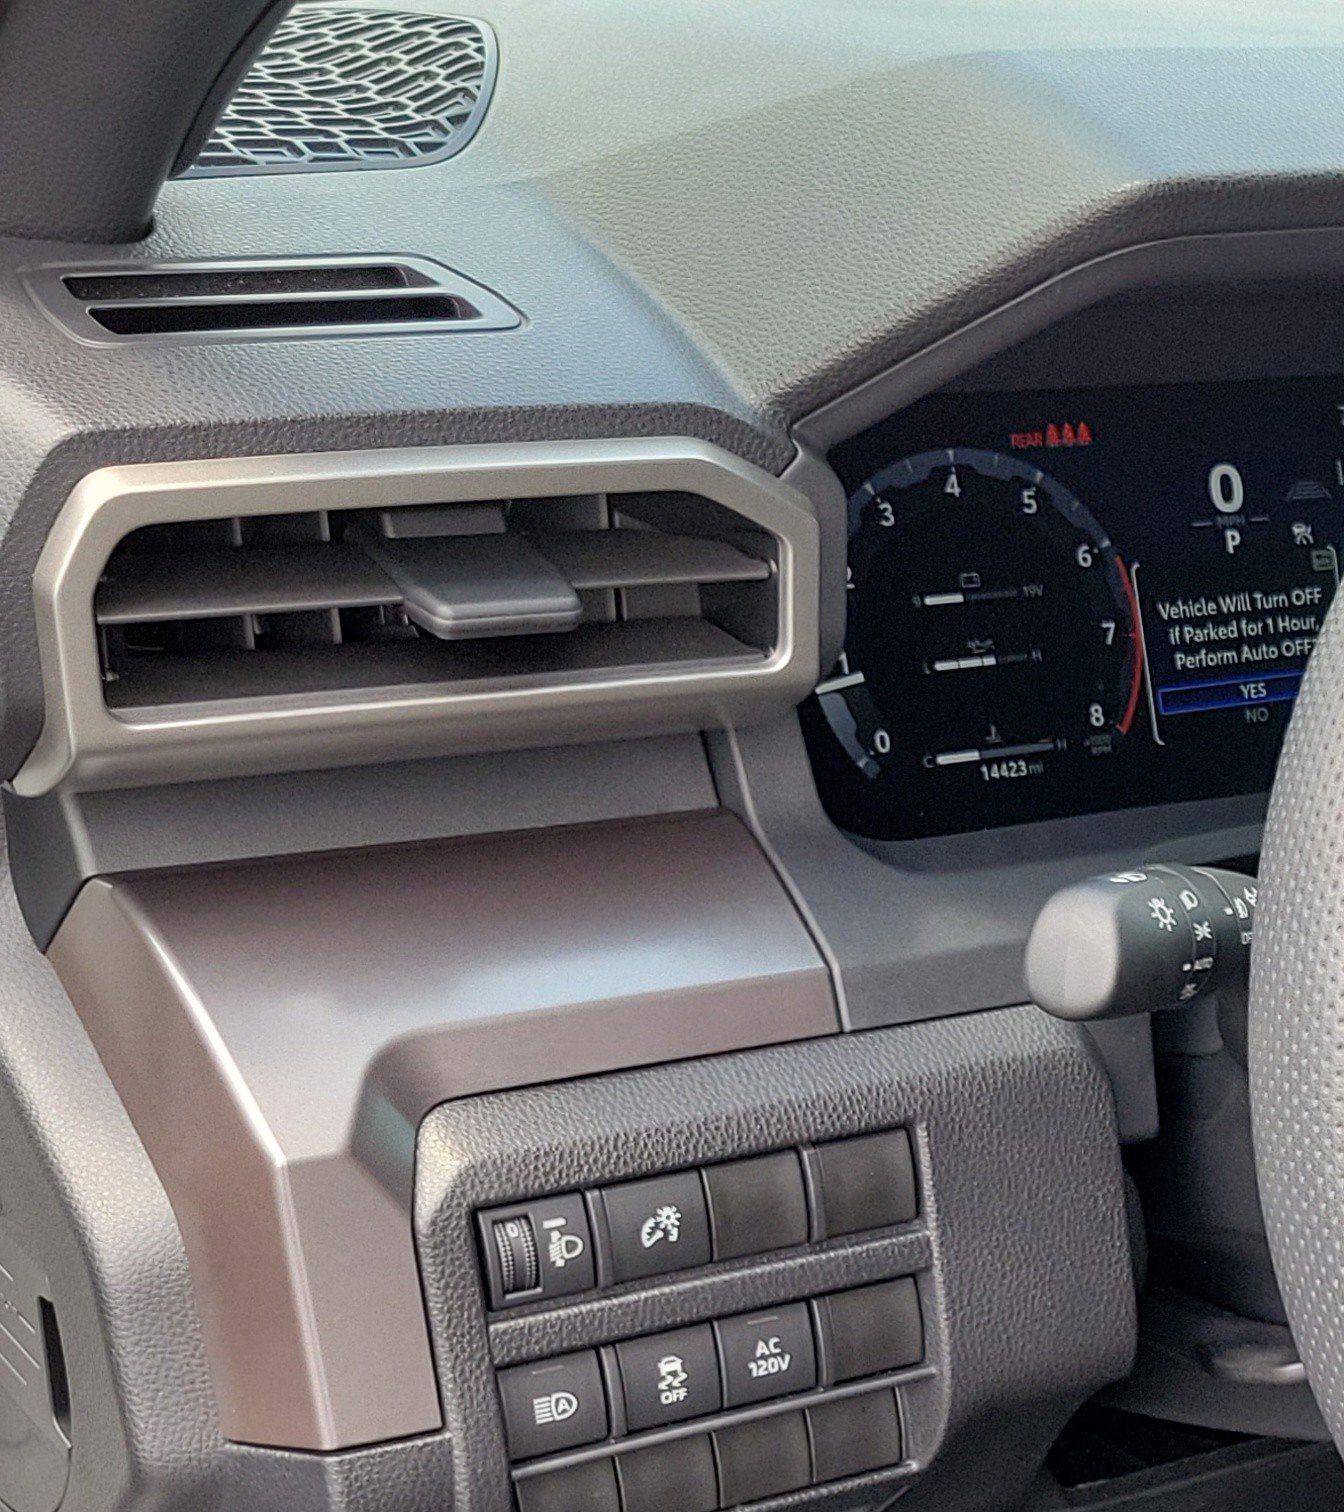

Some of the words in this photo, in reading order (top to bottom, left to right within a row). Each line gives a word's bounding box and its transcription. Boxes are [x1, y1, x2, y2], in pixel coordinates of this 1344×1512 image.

[1011, 433, 1043, 449] REAR
[944, 473, 962, 498] 4
[1208, 463, 1244, 513] 0
[878, 502, 896, 527] 3
[1022, 489, 1038, 515] 5
[1225, 528, 1242, 554] P
[1077, 544, 1093, 568] 6
[1157, 598, 1217, 620] Vehicle
[1218, 591, 1252, 614] Will
[1253, 591, 1289, 610] Turn
[1292, 587, 1322, 606] OFF
[1101, 620, 1116, 646] 7
[1184, 621, 1239, 644] Parked
[1242, 620, 1263, 638] for
[1266, 618, 1274, 634] 1
[1278, 615, 1320, 633] Hour,
[1175, 648, 1239, 670] Perform
[1242, 643, 1279, 662] Auto
[1239, 683, 1267, 699] YES
[1089, 703, 1105, 727] 8
[1246, 707, 1269, 723] NO
[873, 727, 891, 753] 0
[980, 759, 1028, 781] 14423
[755, 1336, 782, 1358] AC
[747, 1353, 791, 1378] 120V
[660, 1387, 689, 1406] OFF
